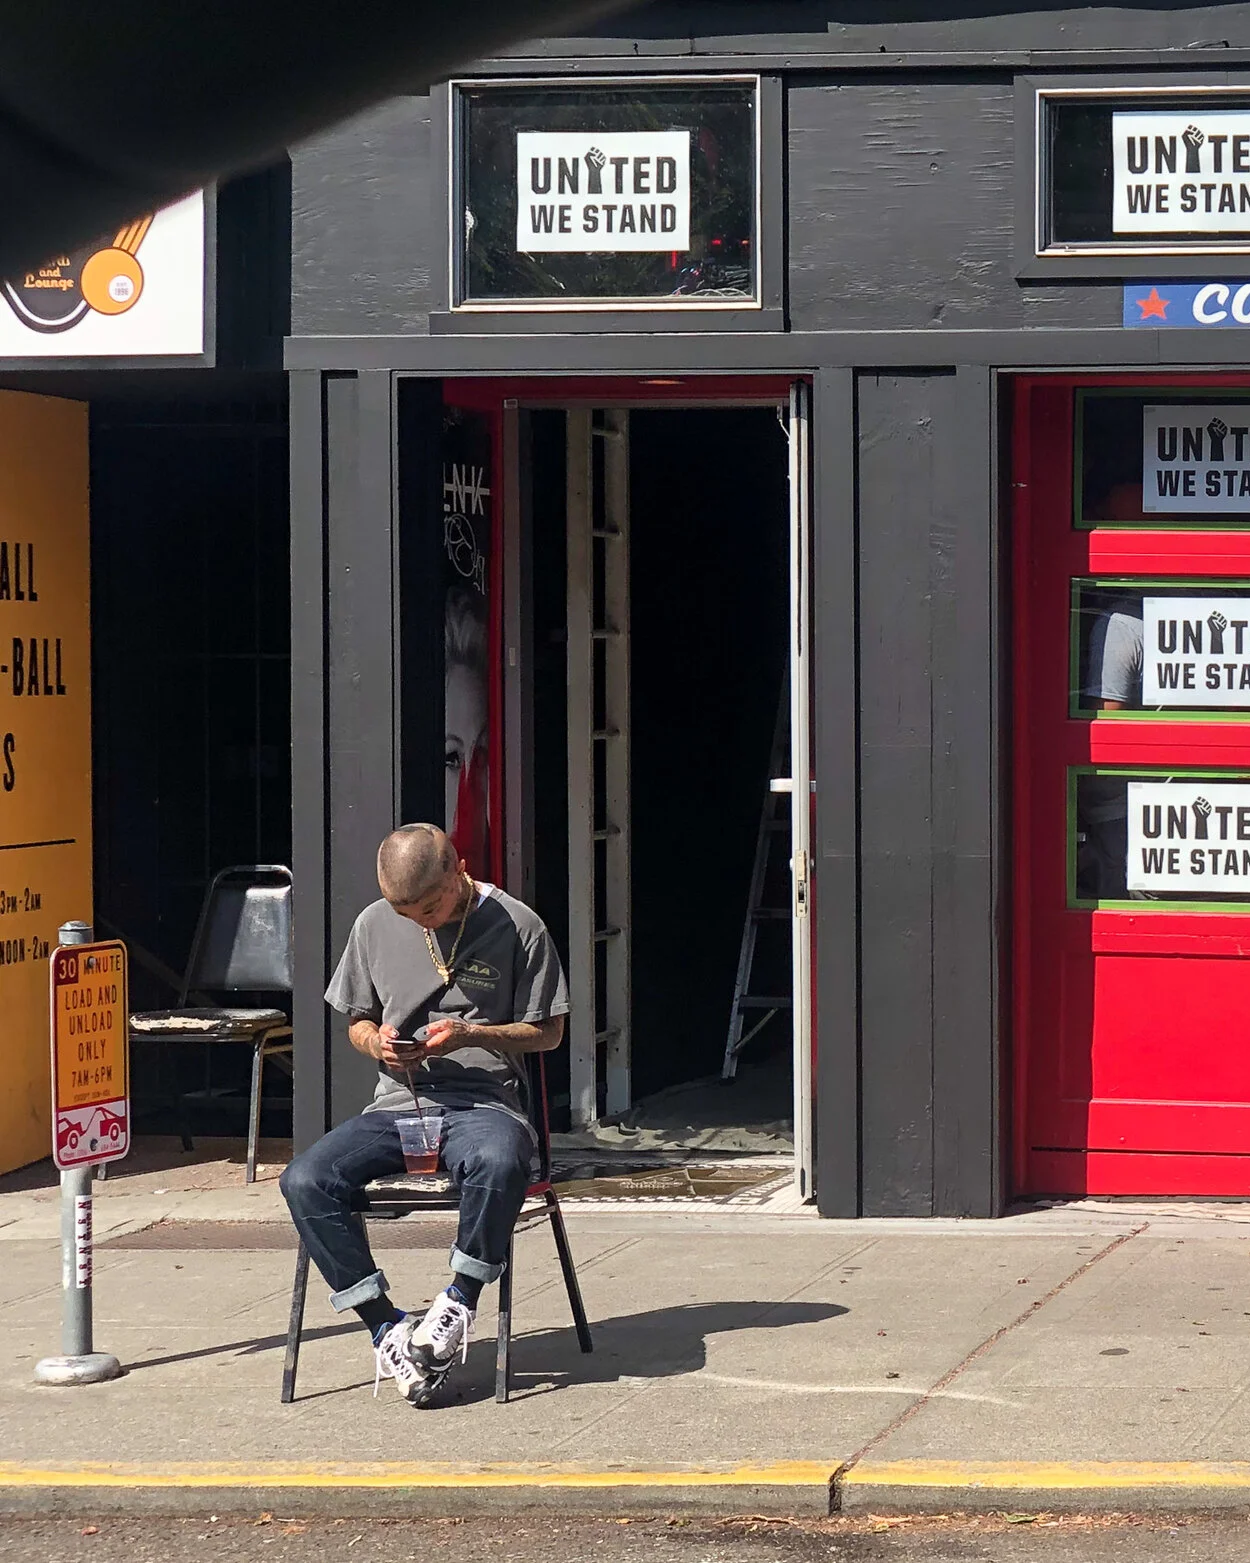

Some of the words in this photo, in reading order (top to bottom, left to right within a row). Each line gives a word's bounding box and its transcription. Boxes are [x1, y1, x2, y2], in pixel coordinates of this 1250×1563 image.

[1127, 185, 1169, 213] WE
[531, 205, 571, 233] WE
[583, 204, 676, 233] STAND
[24, 274, 74, 291] Lounge
[39, 266, 61, 277] and
[1157, 470, 1195, 496] WE
[1157, 663, 1195, 689] WE
[1142, 848, 1180, 874] WE
[59, 957, 77, 979] 30
[65, 988, 92, 1011] LOAD
[98, 984, 117, 1006] AND
[69, 1010, 113, 1035] UNLOAD
[78, 1039, 106, 1062] ONLY
[71, 1065, 113, 1088] 7AM-6PM
